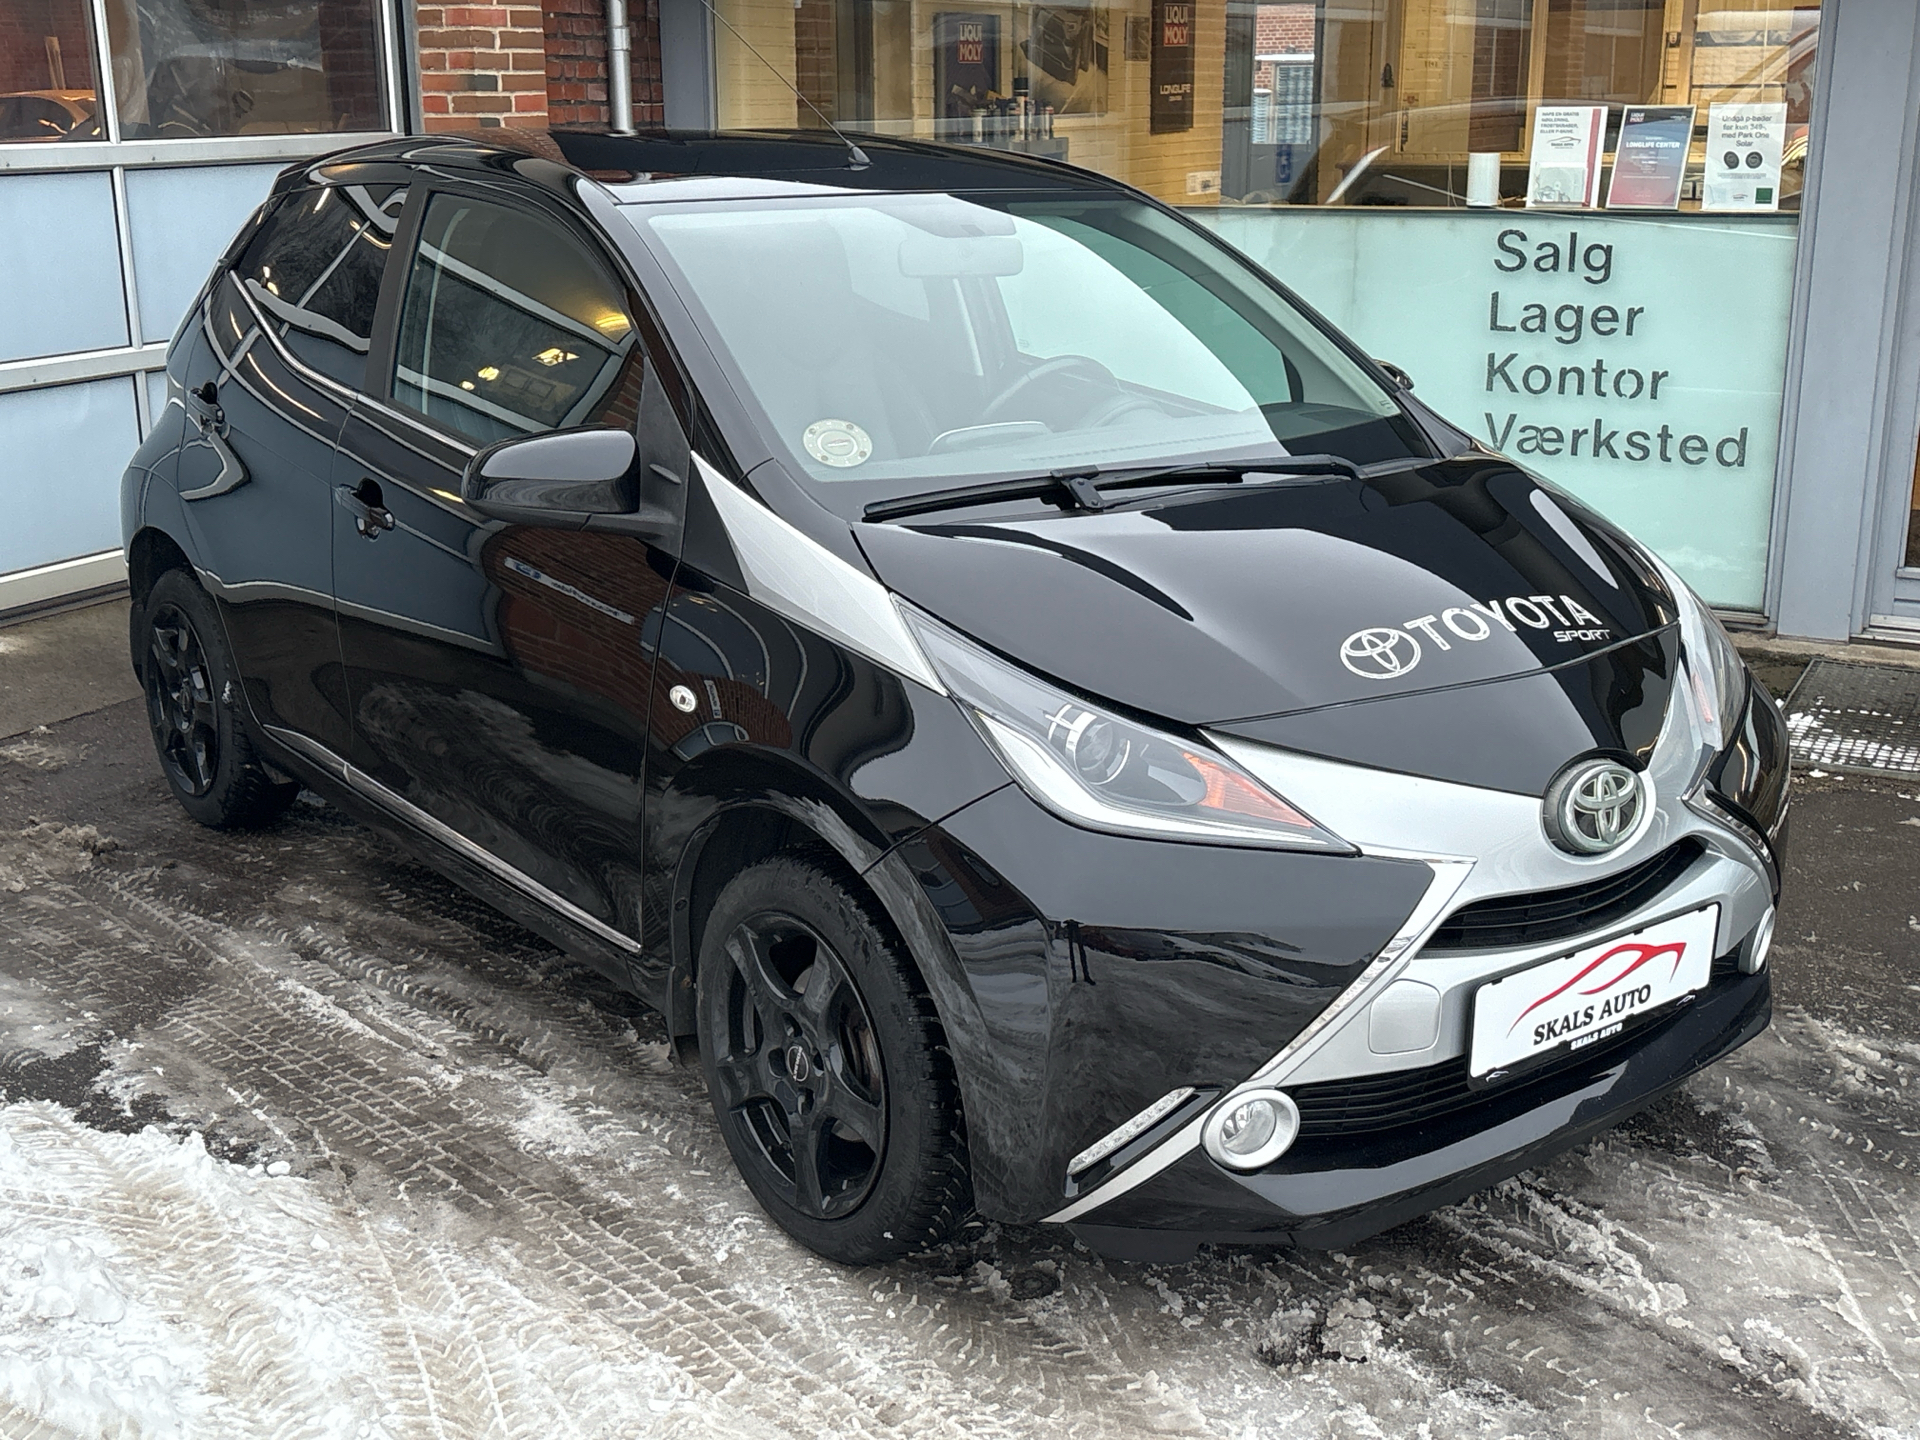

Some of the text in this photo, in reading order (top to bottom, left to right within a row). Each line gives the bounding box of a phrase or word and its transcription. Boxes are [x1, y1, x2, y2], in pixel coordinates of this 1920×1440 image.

[1165, 6, 1188, 24] LIQUI
[959, 24, 983, 42] LIQUI
[1165, 26, 1188, 44] MOLY
[959, 43, 983, 61] MOLY
[1160, 83, 1191, 95] LONGLIFE
[1655, 141, 1681, 149] CENTER
[1494, 229, 1613, 285] Salg
[1489, 291, 1645, 345] Lager
[1485, 352, 1669, 400] Kontor
[1485, 412, 1749, 467] Værksted
[1403, 595, 1603, 651] TOYOTA
[1553, 628, 1611, 643] SPORT
[1533, 984, 1651, 1046] SKALS AUTO
[1570, 1022, 1623, 1051] SKALS AUTO
